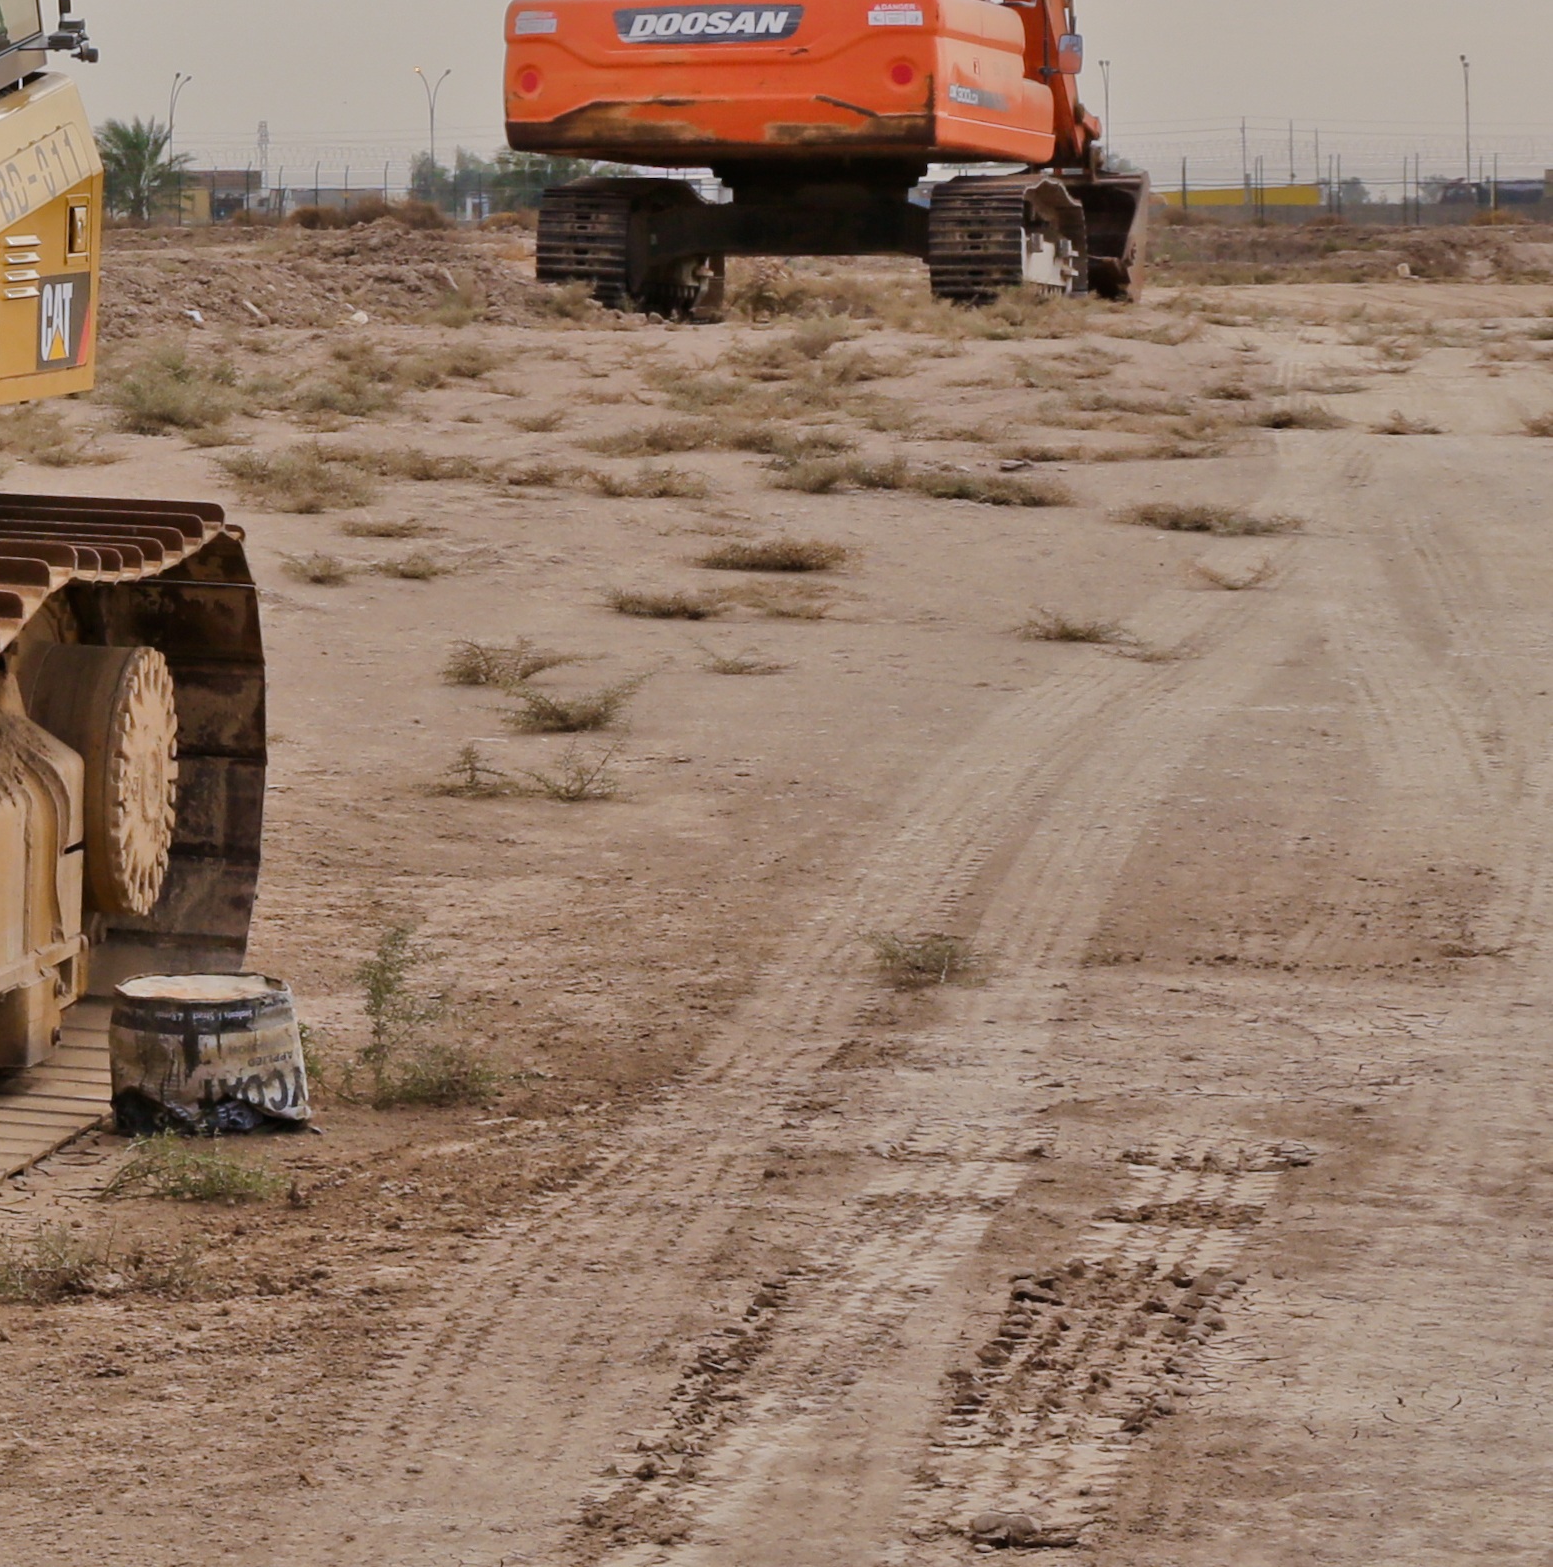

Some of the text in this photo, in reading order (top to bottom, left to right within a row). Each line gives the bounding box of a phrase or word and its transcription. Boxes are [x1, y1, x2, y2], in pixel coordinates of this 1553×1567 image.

[629, 11, 789, 37] DOOSAN
[41, 282, 73, 361] CAT
[248, 1051, 293, 1067] APPLIED
